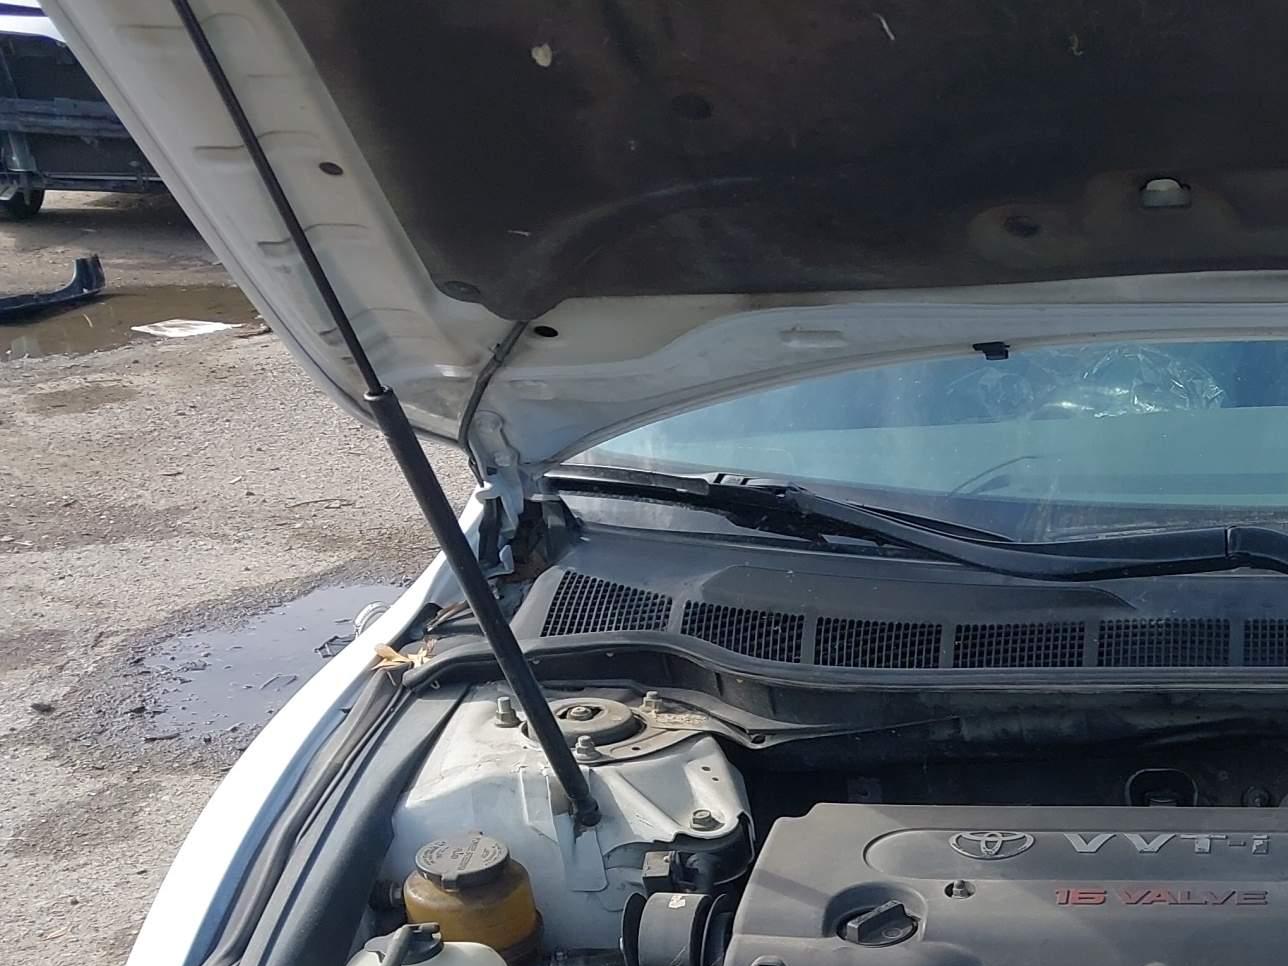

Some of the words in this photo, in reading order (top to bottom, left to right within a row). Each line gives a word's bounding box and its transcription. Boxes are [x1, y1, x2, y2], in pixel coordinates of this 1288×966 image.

[1063, 832, 1271, 855] VVT-i
[1055, 887, 1108, 906] 16
[1119, 887, 1269, 906] VALVE
